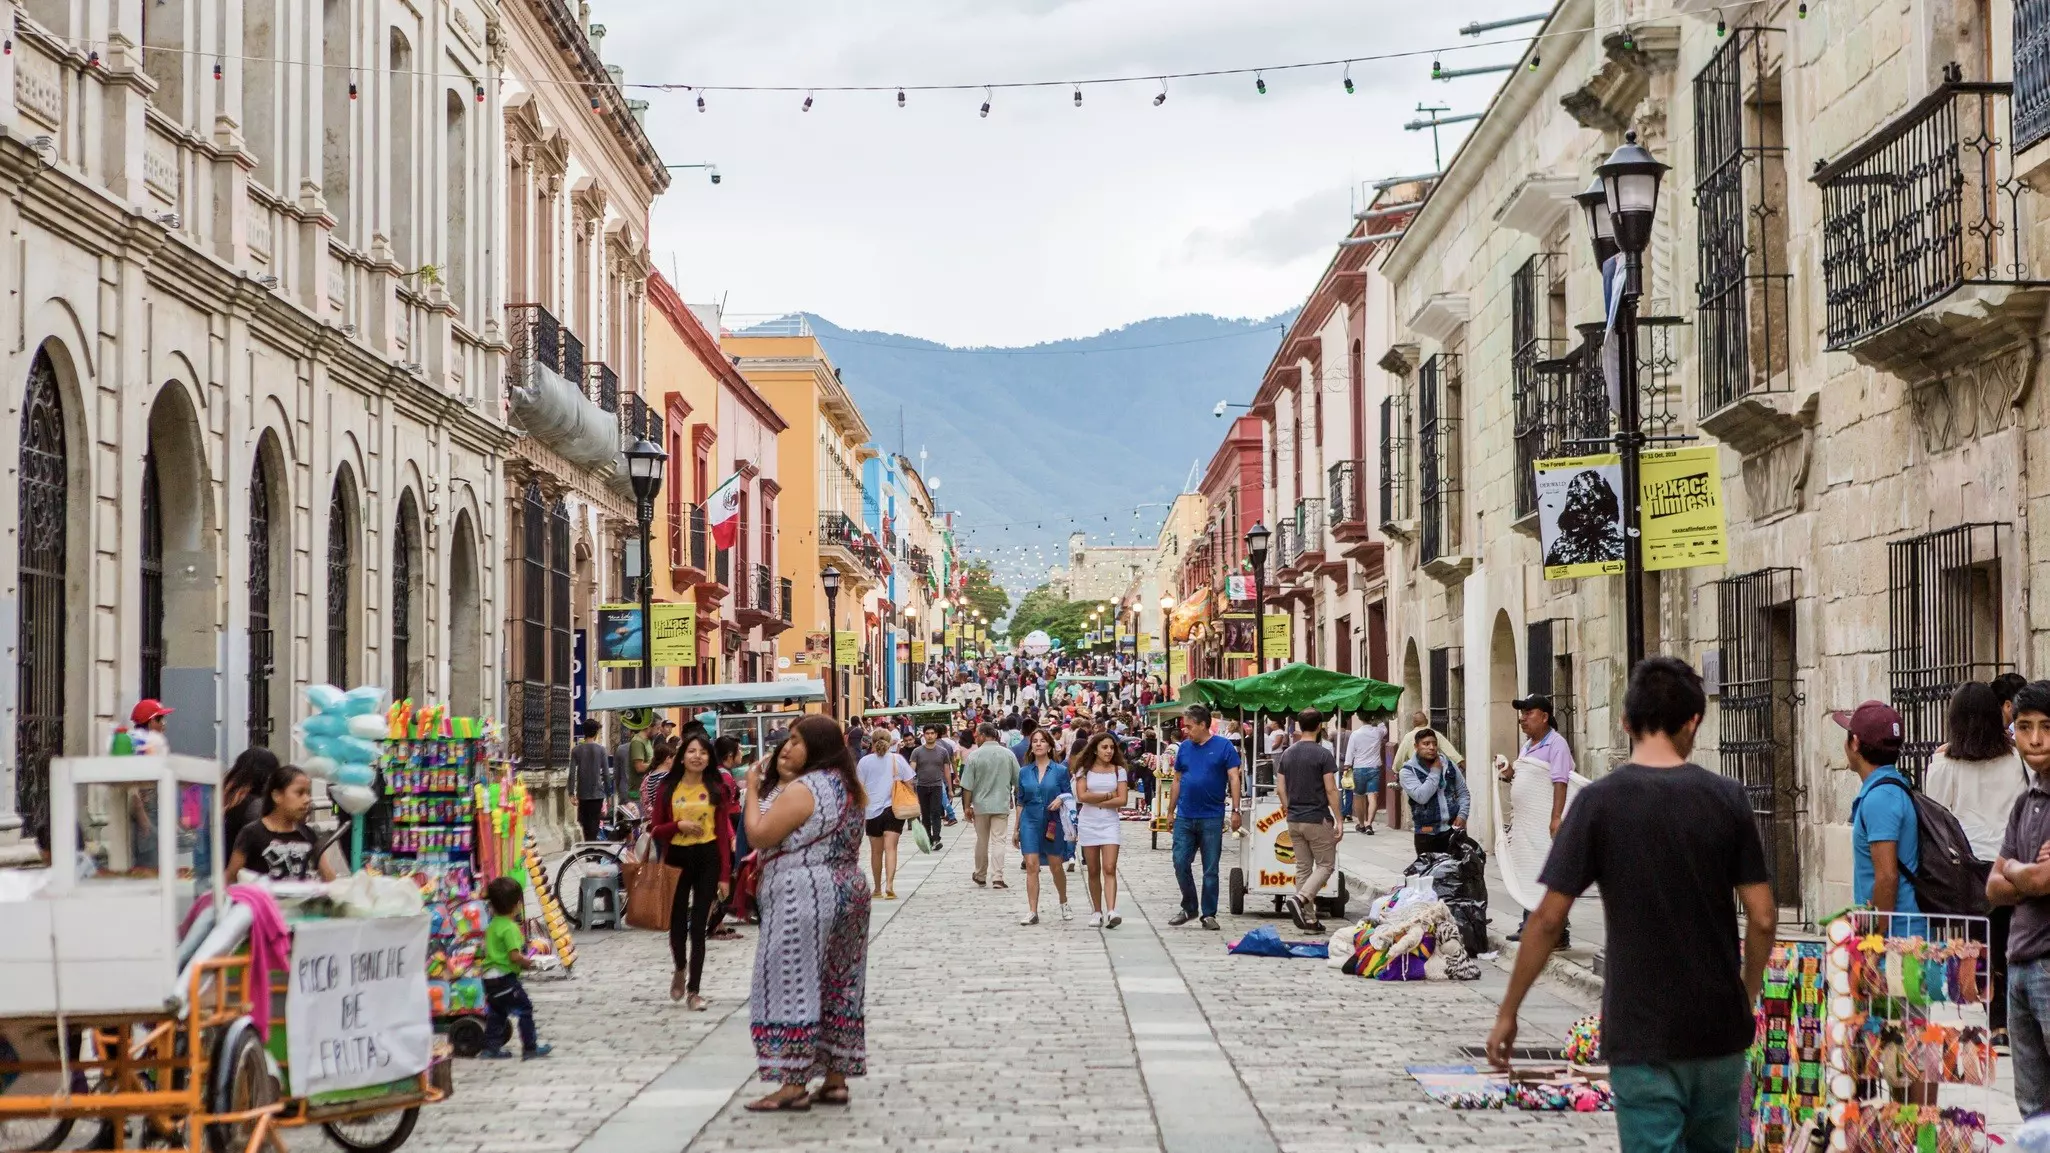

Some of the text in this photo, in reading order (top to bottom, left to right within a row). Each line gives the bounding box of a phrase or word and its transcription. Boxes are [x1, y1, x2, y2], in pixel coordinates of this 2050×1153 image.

[1643, 473, 1709, 500] oaxaca
[350, 946, 406, 986] PONCHE
[341, 991, 368, 1030] DE
[320, 1033, 390, 1079] FRUTAS
